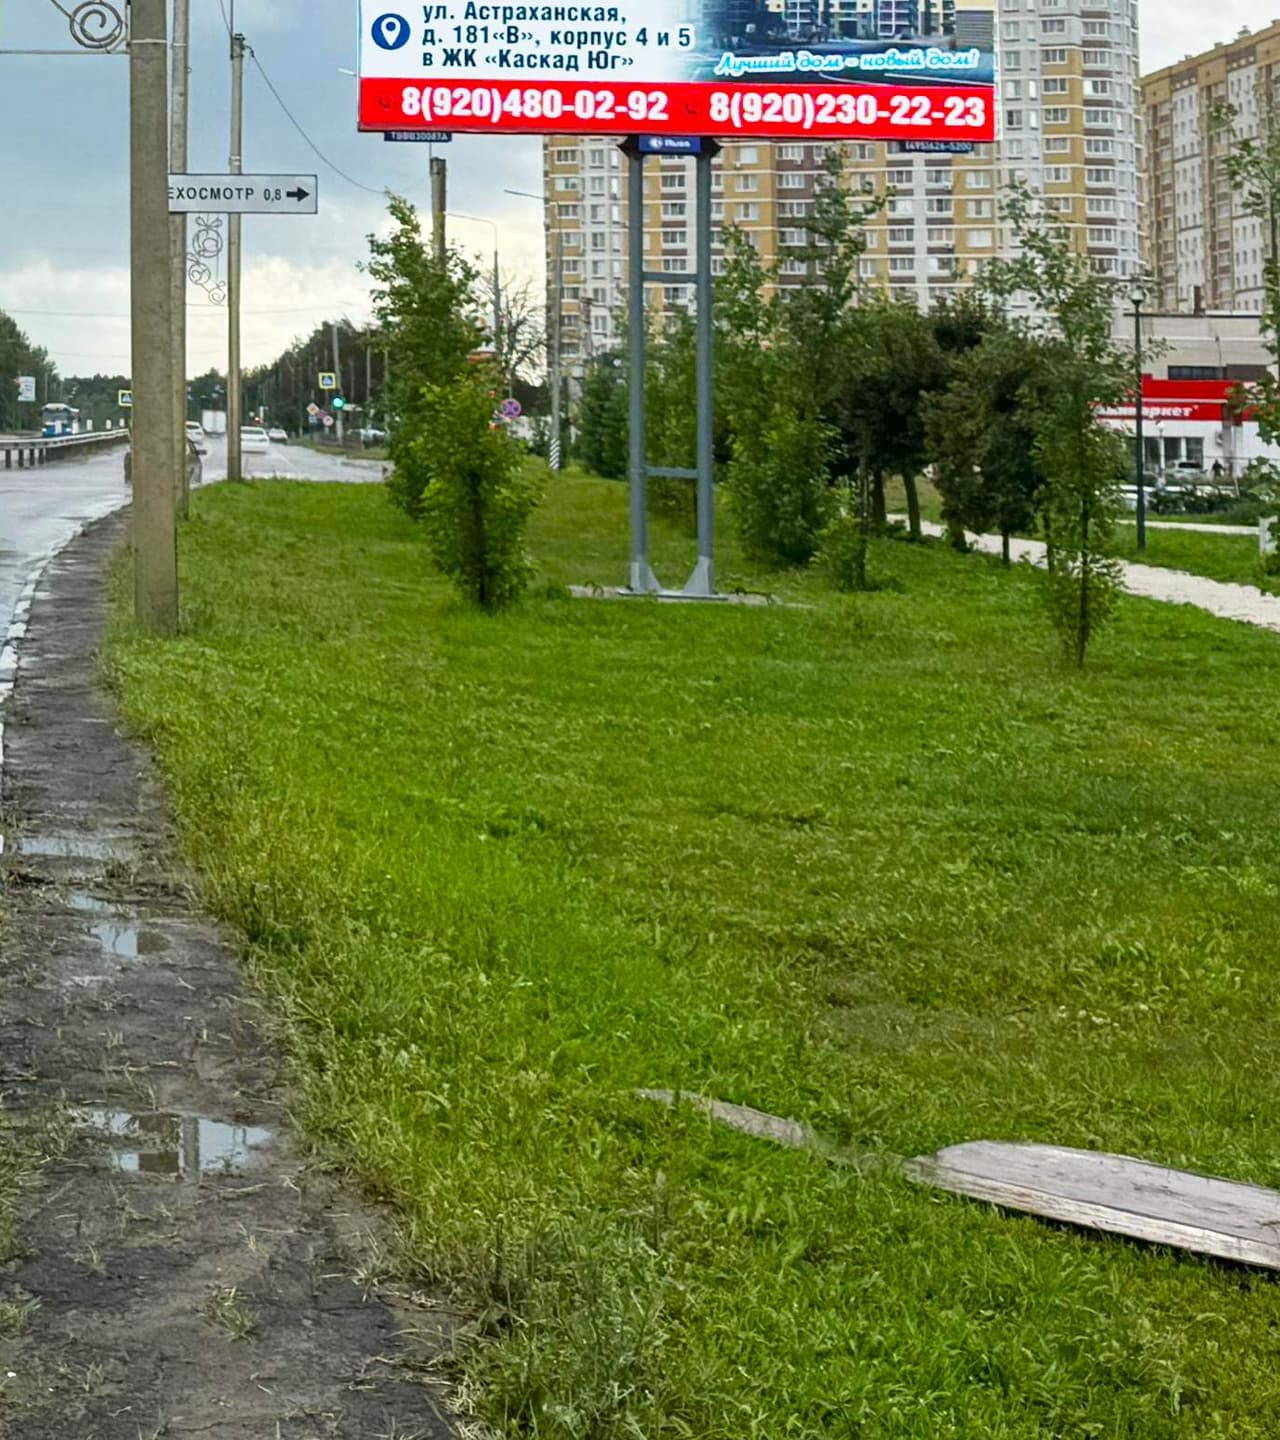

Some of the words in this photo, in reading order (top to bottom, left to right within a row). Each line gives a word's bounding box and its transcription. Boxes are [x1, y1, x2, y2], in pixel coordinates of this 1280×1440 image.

[423, 4, 455, 22] ул.
[464, 1, 627, 24] Астраханская,
[422, 27, 443, 46] д.
[550, 30, 628, 49] корпус
[636, 28, 648, 46] 4
[657, 33, 669, 46] и
[678, 28, 691, 47] 5
[422, 53, 433, 66] в
[442, 49, 477, 67] ЖК
[485, 50, 579, 71] «Каскад
[588, 50, 634, 69] Юг»
[717, 52, 793, 75] Лучший
[798, 51, 842, 69] дом
[861, 49, 924, 69] новый
[926, 49, 979, 68] дом!
[401, 87, 669, 123] 8(920)480-02-92
[709, 92, 986, 129] 8(920)230-22-23
[168, 187, 254, 201] ЕХОСМОТР
